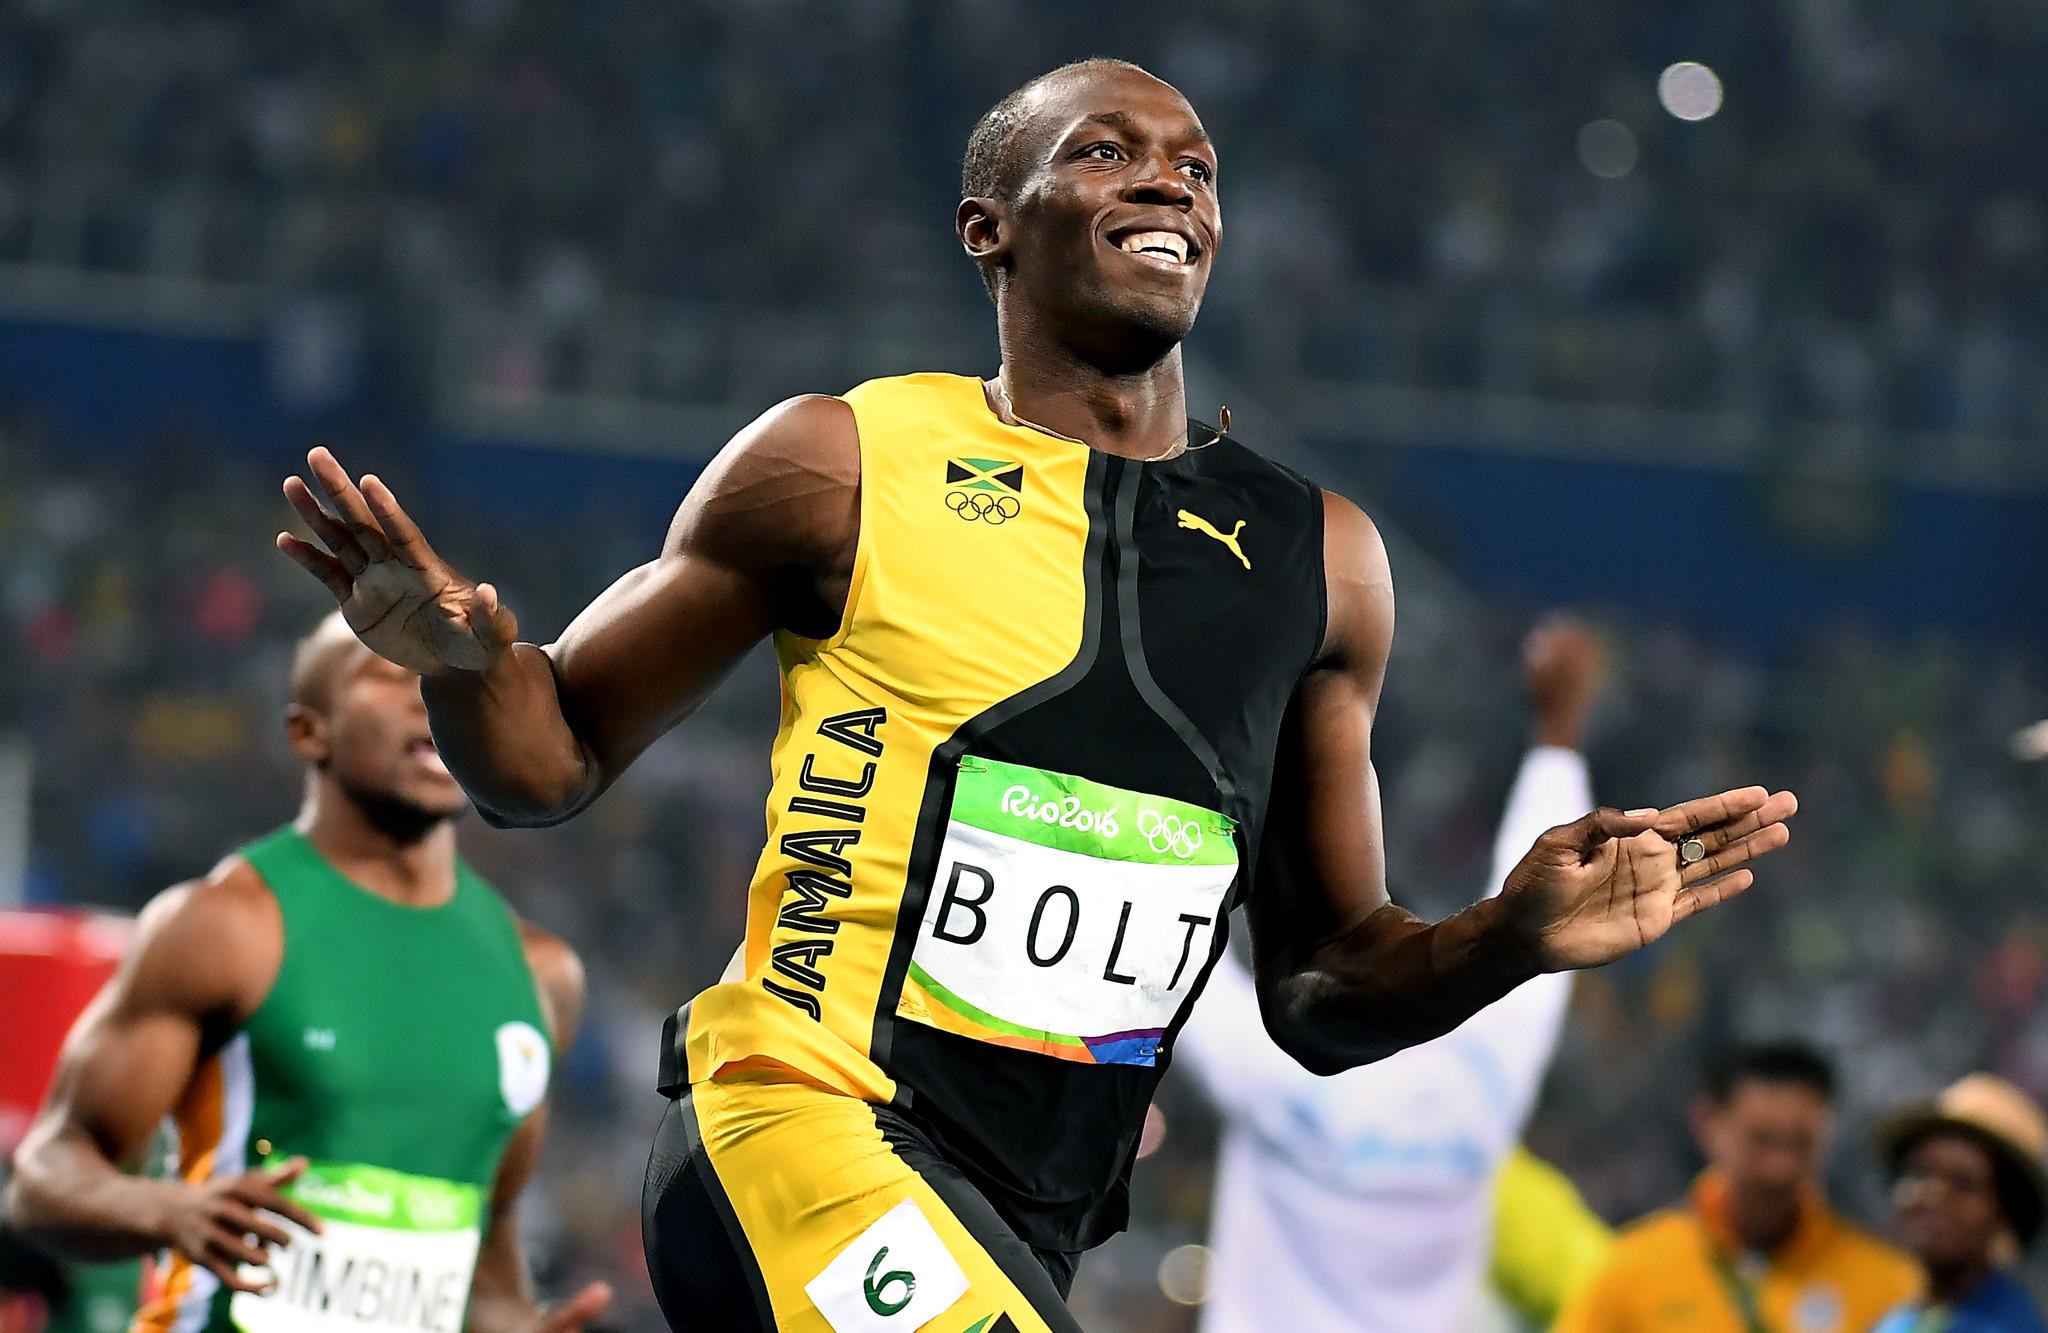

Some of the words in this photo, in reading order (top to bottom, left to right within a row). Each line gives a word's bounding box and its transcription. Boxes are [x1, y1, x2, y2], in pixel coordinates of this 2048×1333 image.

[762, 706, 887, 1022] JAMAICA
[932, 860, 1212, 992] BOLT
[262, 1242, 461, 1332] IMBINE
[863, 1245, 917, 1317] 6
